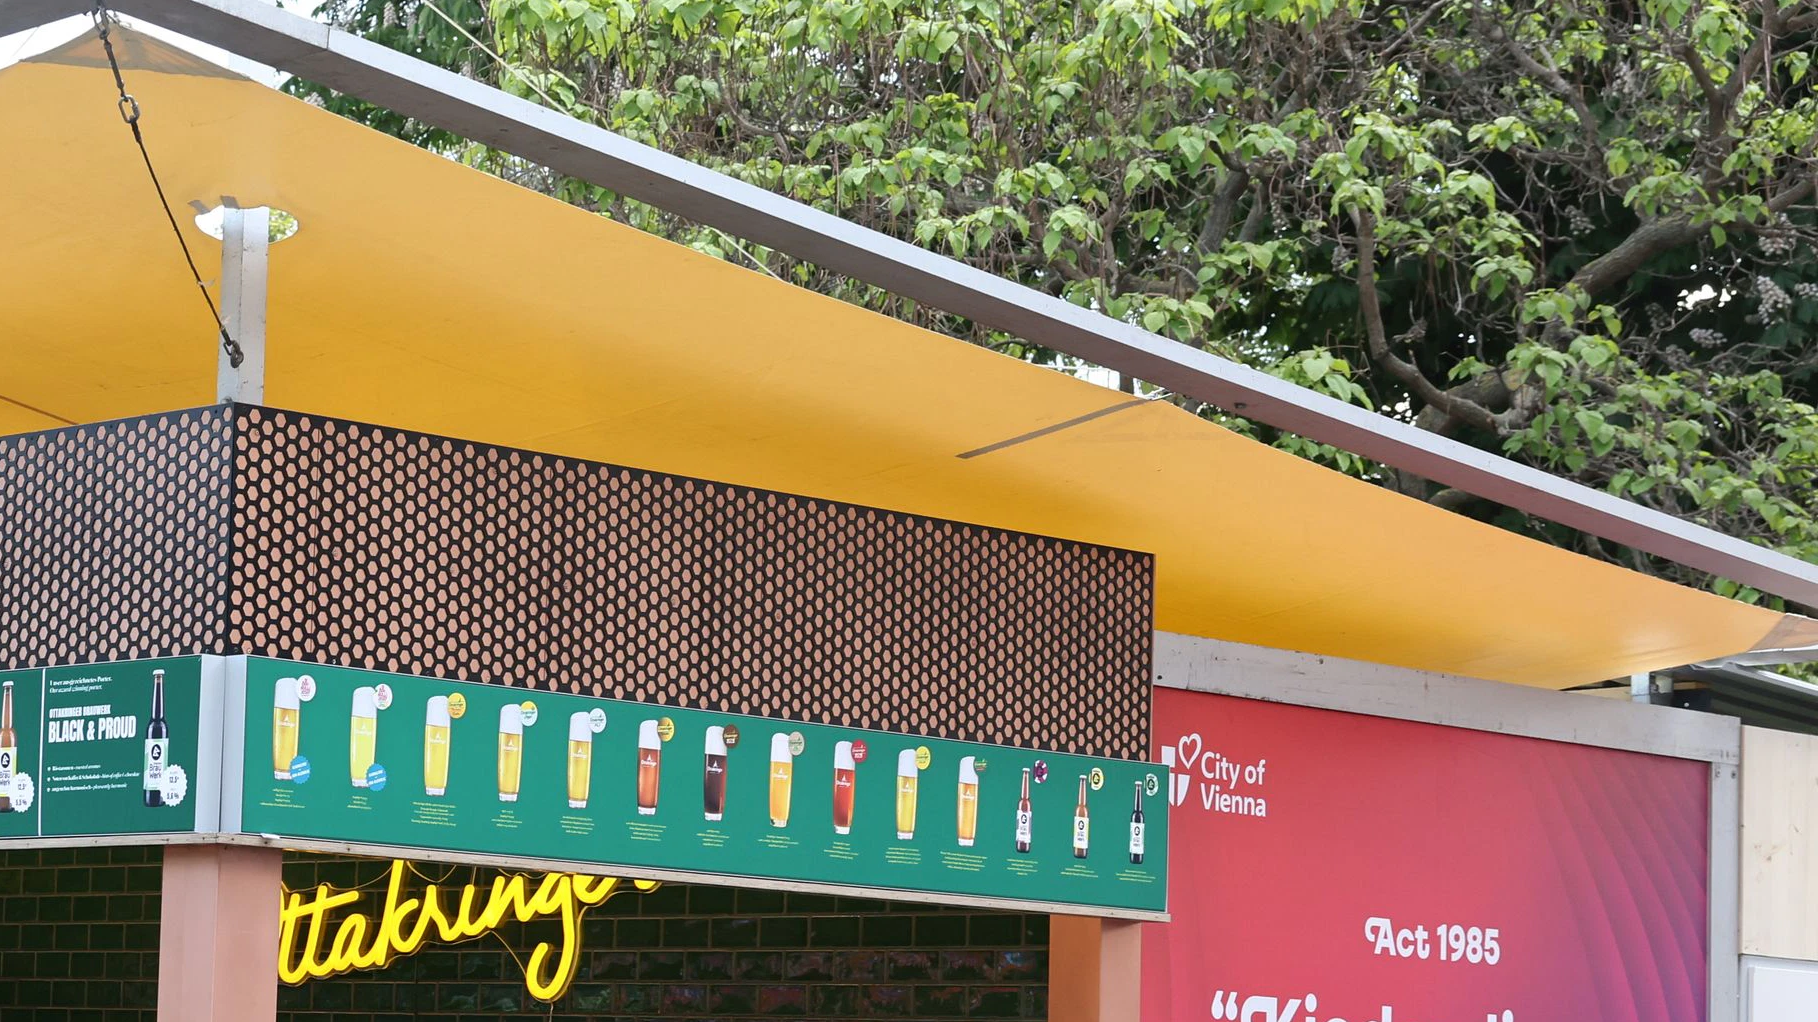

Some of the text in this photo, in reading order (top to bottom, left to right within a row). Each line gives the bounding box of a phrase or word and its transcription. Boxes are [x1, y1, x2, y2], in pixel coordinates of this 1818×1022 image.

[48, 716, 137, 743] BLACK & PROUD
[1201, 751, 1266, 790] City of
[1200, 783, 1266, 817] Vienna
[279, 859, 660, 1000] ttakring
[1364, 917, 1501, 965] Act 1985
